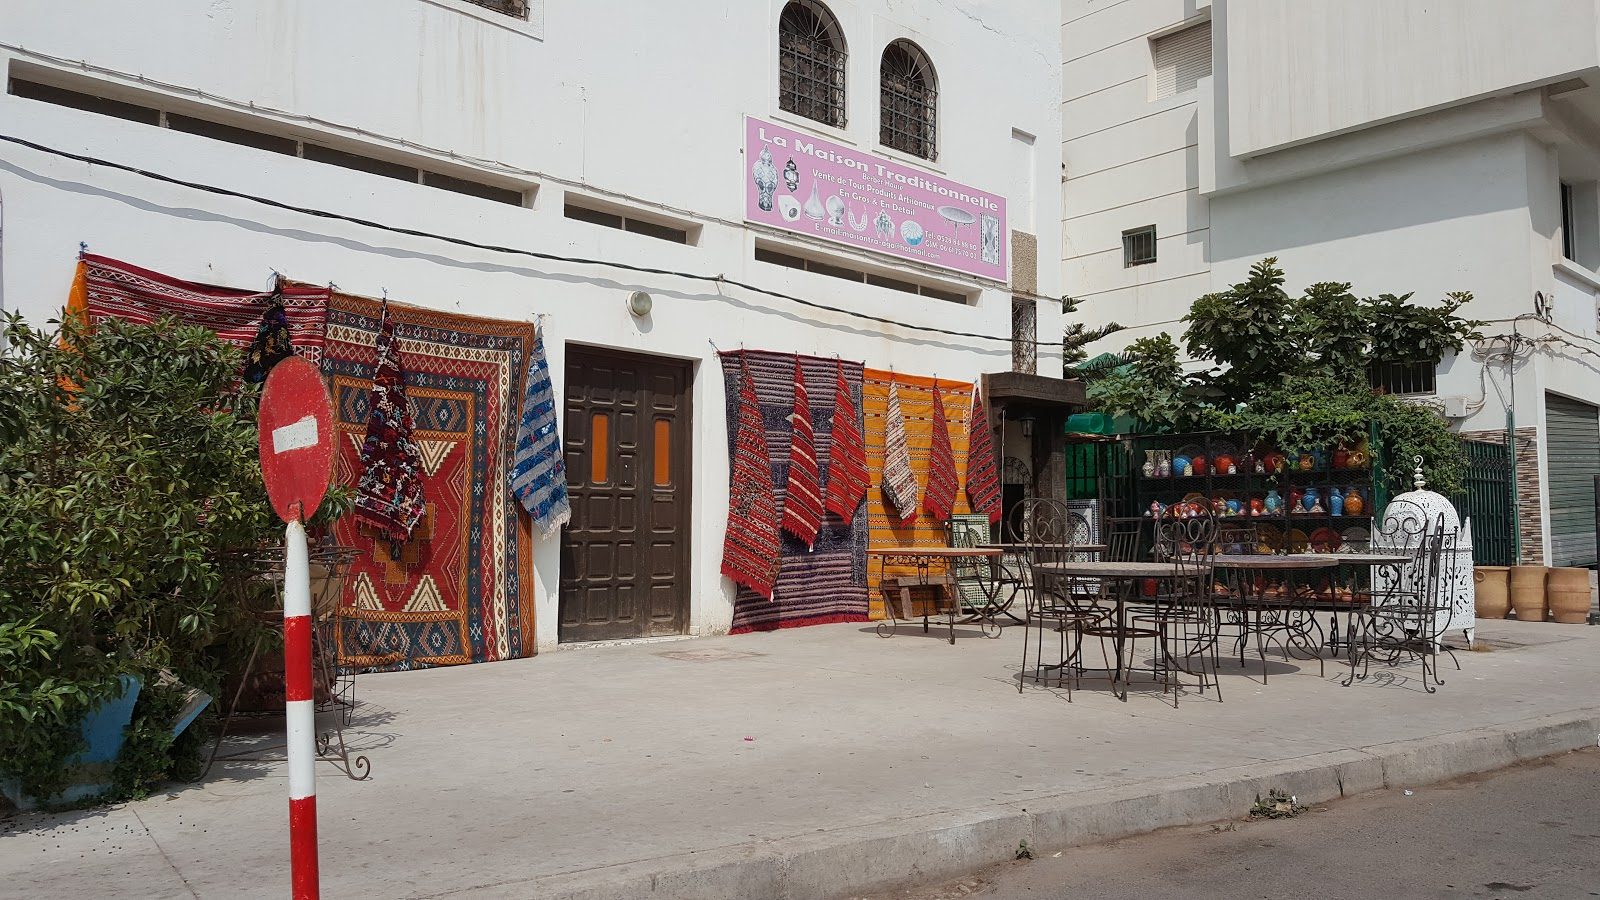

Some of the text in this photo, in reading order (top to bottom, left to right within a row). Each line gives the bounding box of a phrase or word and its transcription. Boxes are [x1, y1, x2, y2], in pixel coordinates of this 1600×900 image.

[759, 128, 999, 212] La Maison Traditionnelle
[812, 168, 836, 183] Vente
[837, 177, 847, 186] de
[848, 179, 866, 191] Tous
[866, 184, 897, 201] Produits
[839, 188, 850, 198] En
[851, 192, 870, 204] Gros
[872, 197, 879, 206] &
[880, 200, 890, 209] En
